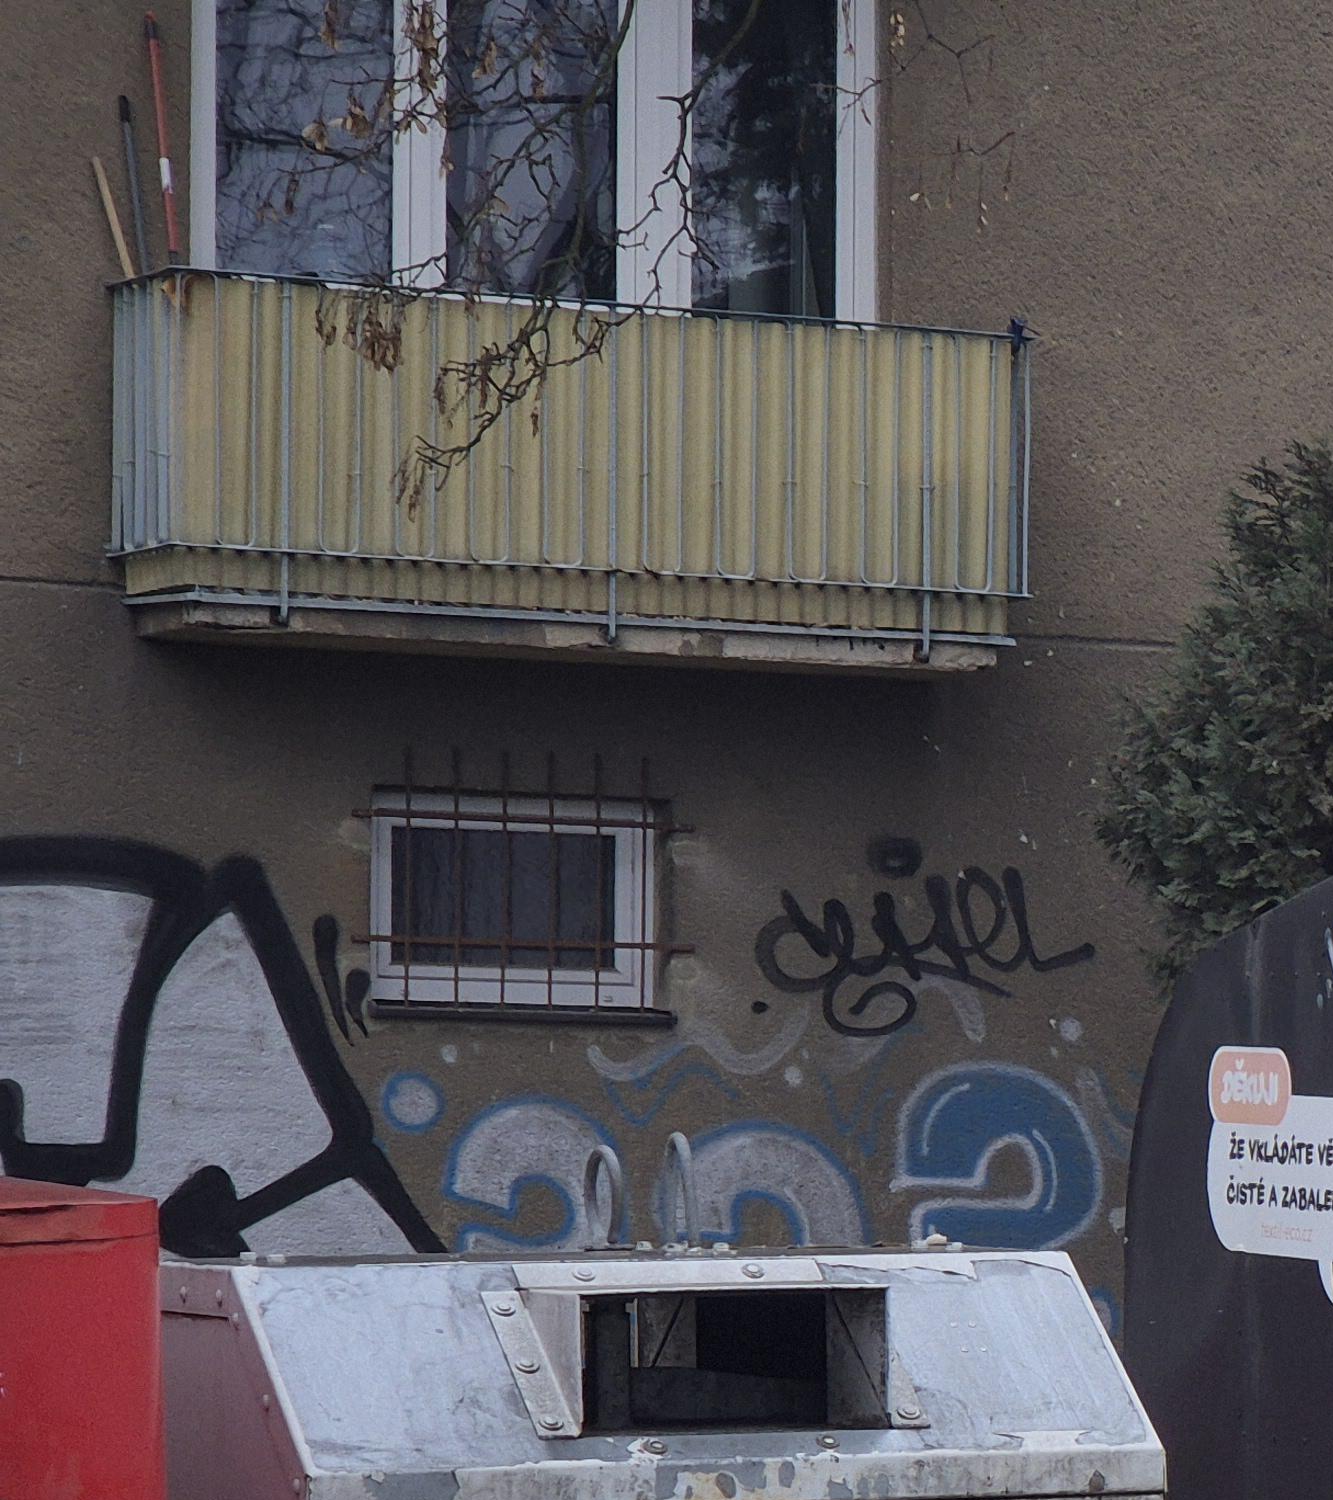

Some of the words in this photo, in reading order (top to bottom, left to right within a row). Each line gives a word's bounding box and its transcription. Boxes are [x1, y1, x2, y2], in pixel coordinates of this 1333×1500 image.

[1229, 1131, 1245, 1160] ŽE
[1249, 1134, 1314, 1165] VKLÁDÁTE
[1226, 1174, 1265, 1205] ČISTÉ
[1268, 1184, 1278, 1207] A
